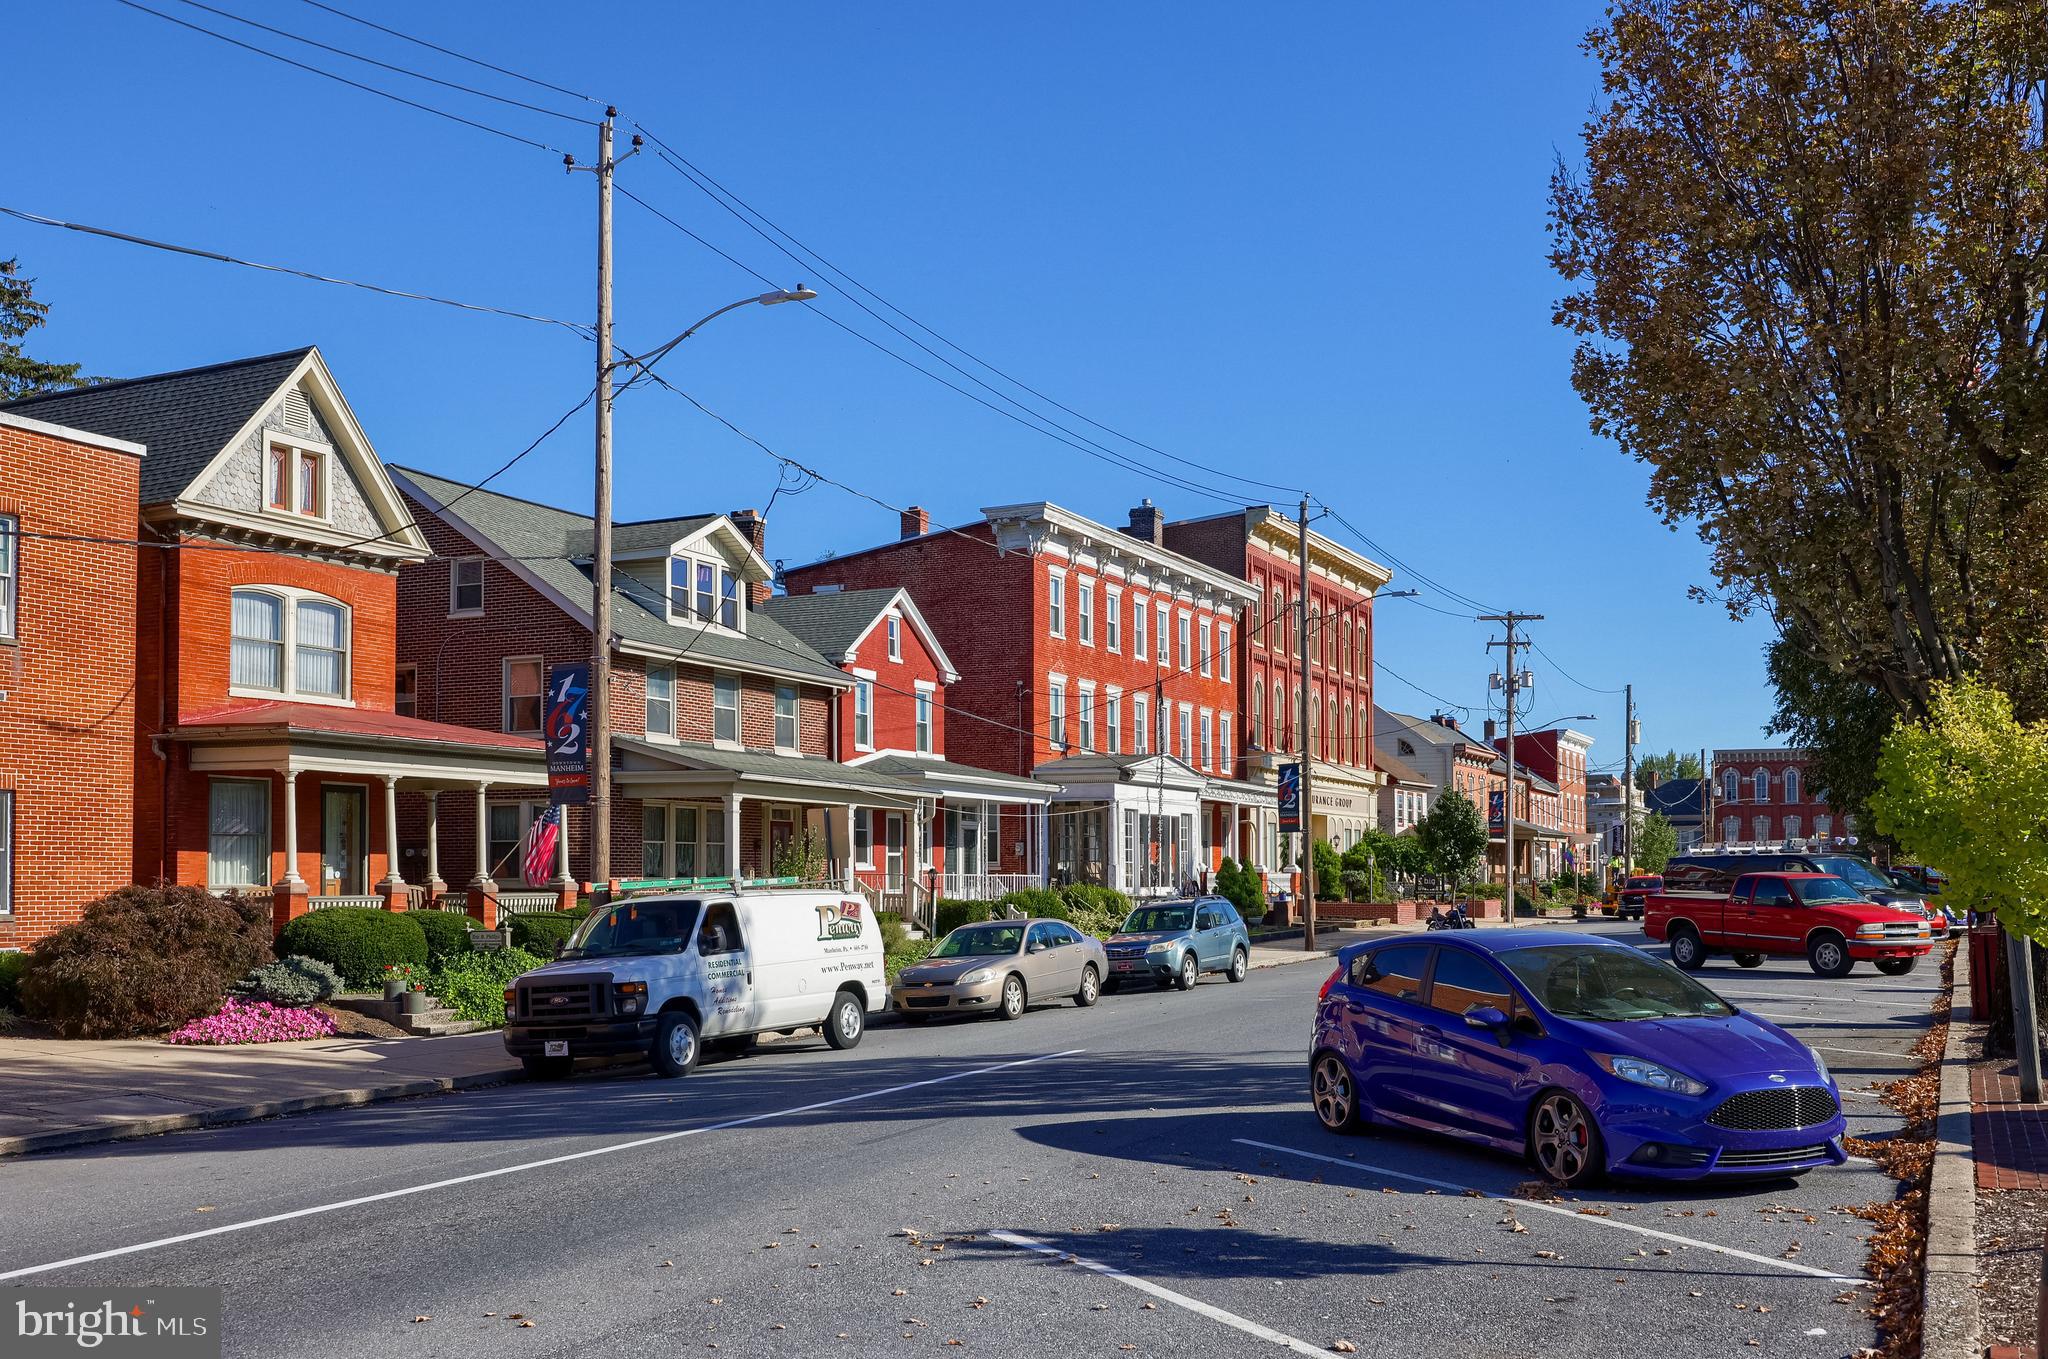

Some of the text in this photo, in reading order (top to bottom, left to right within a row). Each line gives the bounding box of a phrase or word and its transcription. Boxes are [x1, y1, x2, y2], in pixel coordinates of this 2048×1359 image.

[1311, 795, 1353, 809] URANCE GROUP
[708, 958, 742, 969] RESIDENTIAL
[821, 961, 874, 974] www.Penway.net
[708, 969, 745, 980] COMMERCIAL
